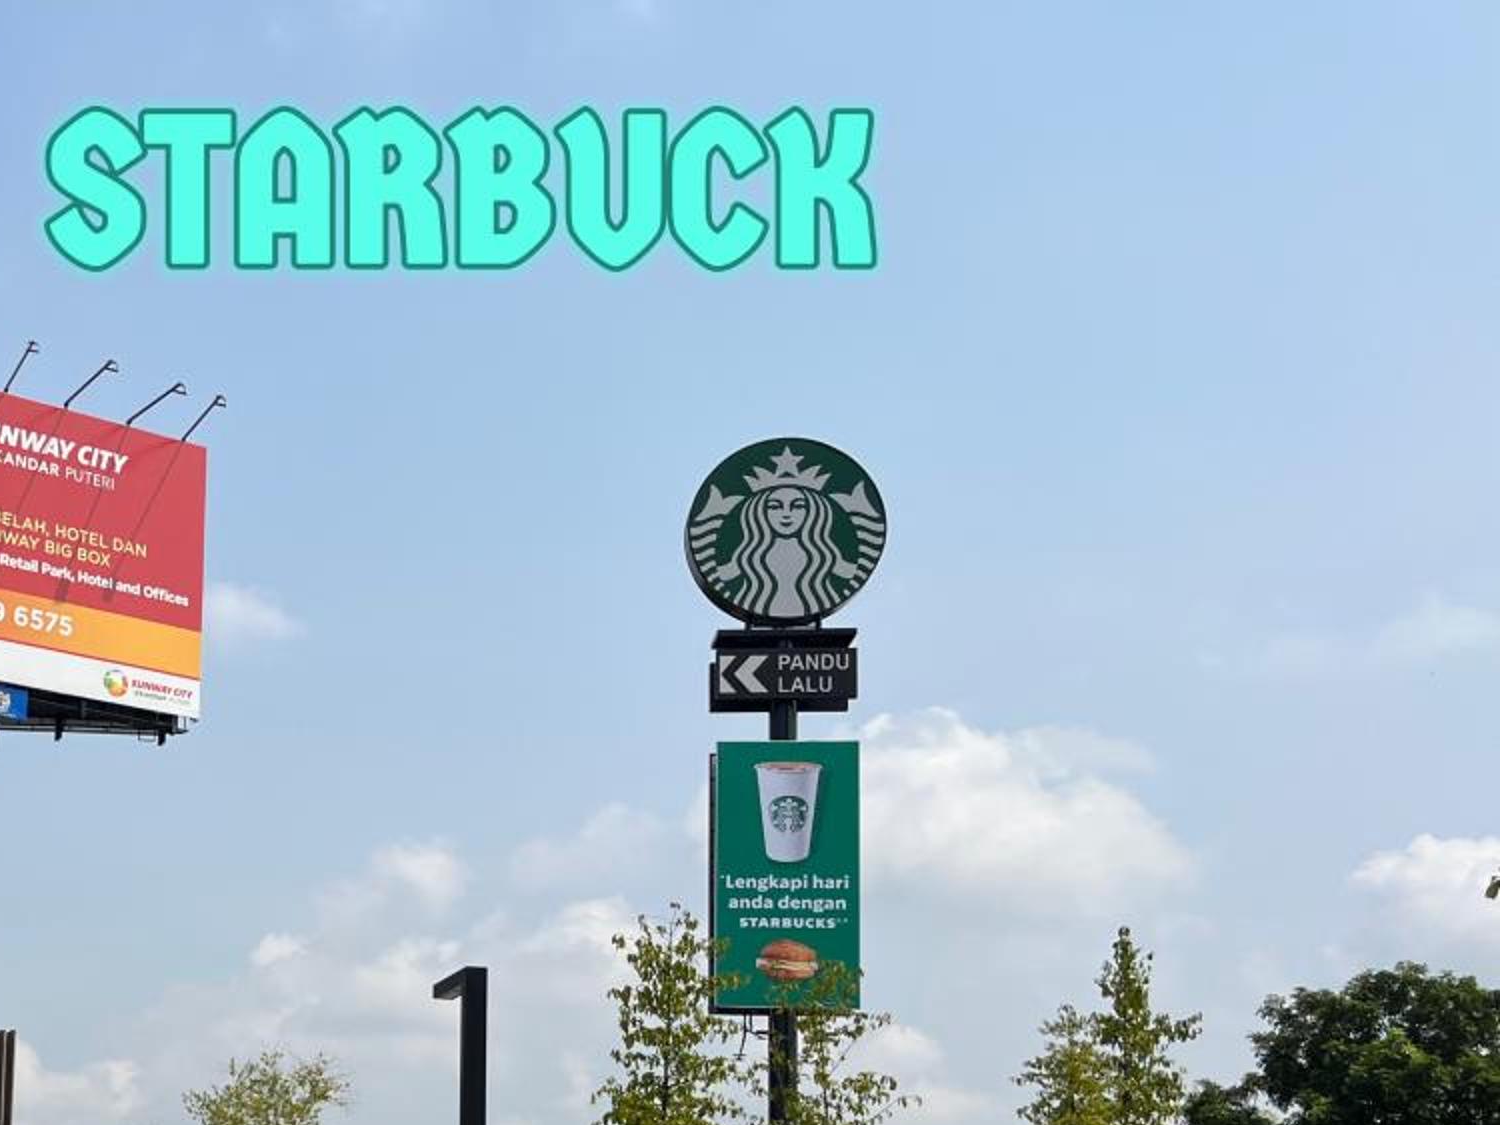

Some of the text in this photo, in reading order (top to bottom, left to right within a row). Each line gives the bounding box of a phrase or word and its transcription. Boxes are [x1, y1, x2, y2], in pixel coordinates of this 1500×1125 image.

[77, 445, 130, 474] CITY
[64, 466, 116, 491] PUTERI
[45, 539, 73, 558] BIG
[77, 546, 112, 568] BOX
[55, 523, 109, 550] HOTEL
[112, 537, 148, 558] DAN
[0, 552, 40, 574] Retail
[41, 561, 76, 584] Park,
[77, 571, 113, 589] Hotel
[115, 577, 147, 596] and
[143, 585, 190, 608] Offices
[13, 606, 75, 637] 6575
[777, 653, 850, 671] PANDU
[777, 675, 834, 693] LALU
[812, 873, 850, 889] hari
[728, 895, 847, 912] anda dengan
